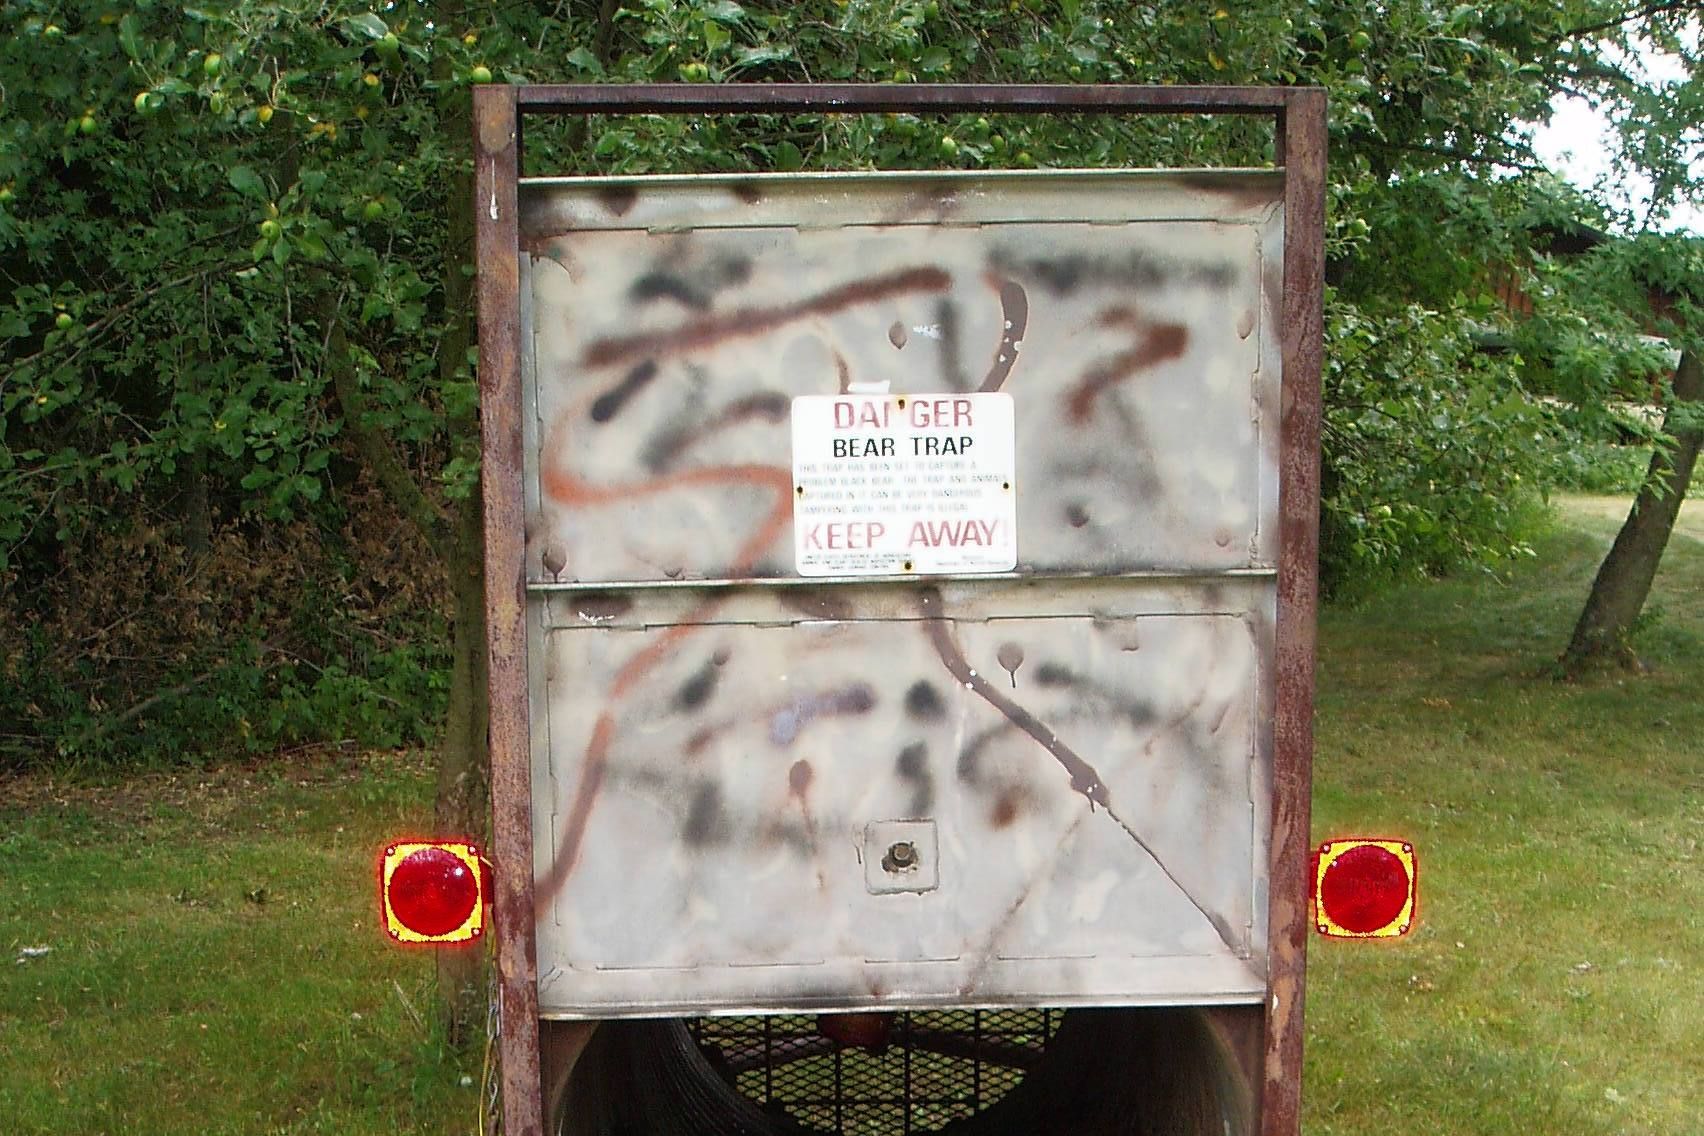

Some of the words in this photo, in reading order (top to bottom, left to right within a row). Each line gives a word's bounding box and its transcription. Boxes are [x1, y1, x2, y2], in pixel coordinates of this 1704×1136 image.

[833, 438, 896, 458] BEAR
[909, 436, 974, 456] TRAP
[803, 522, 886, 550] KEEP
